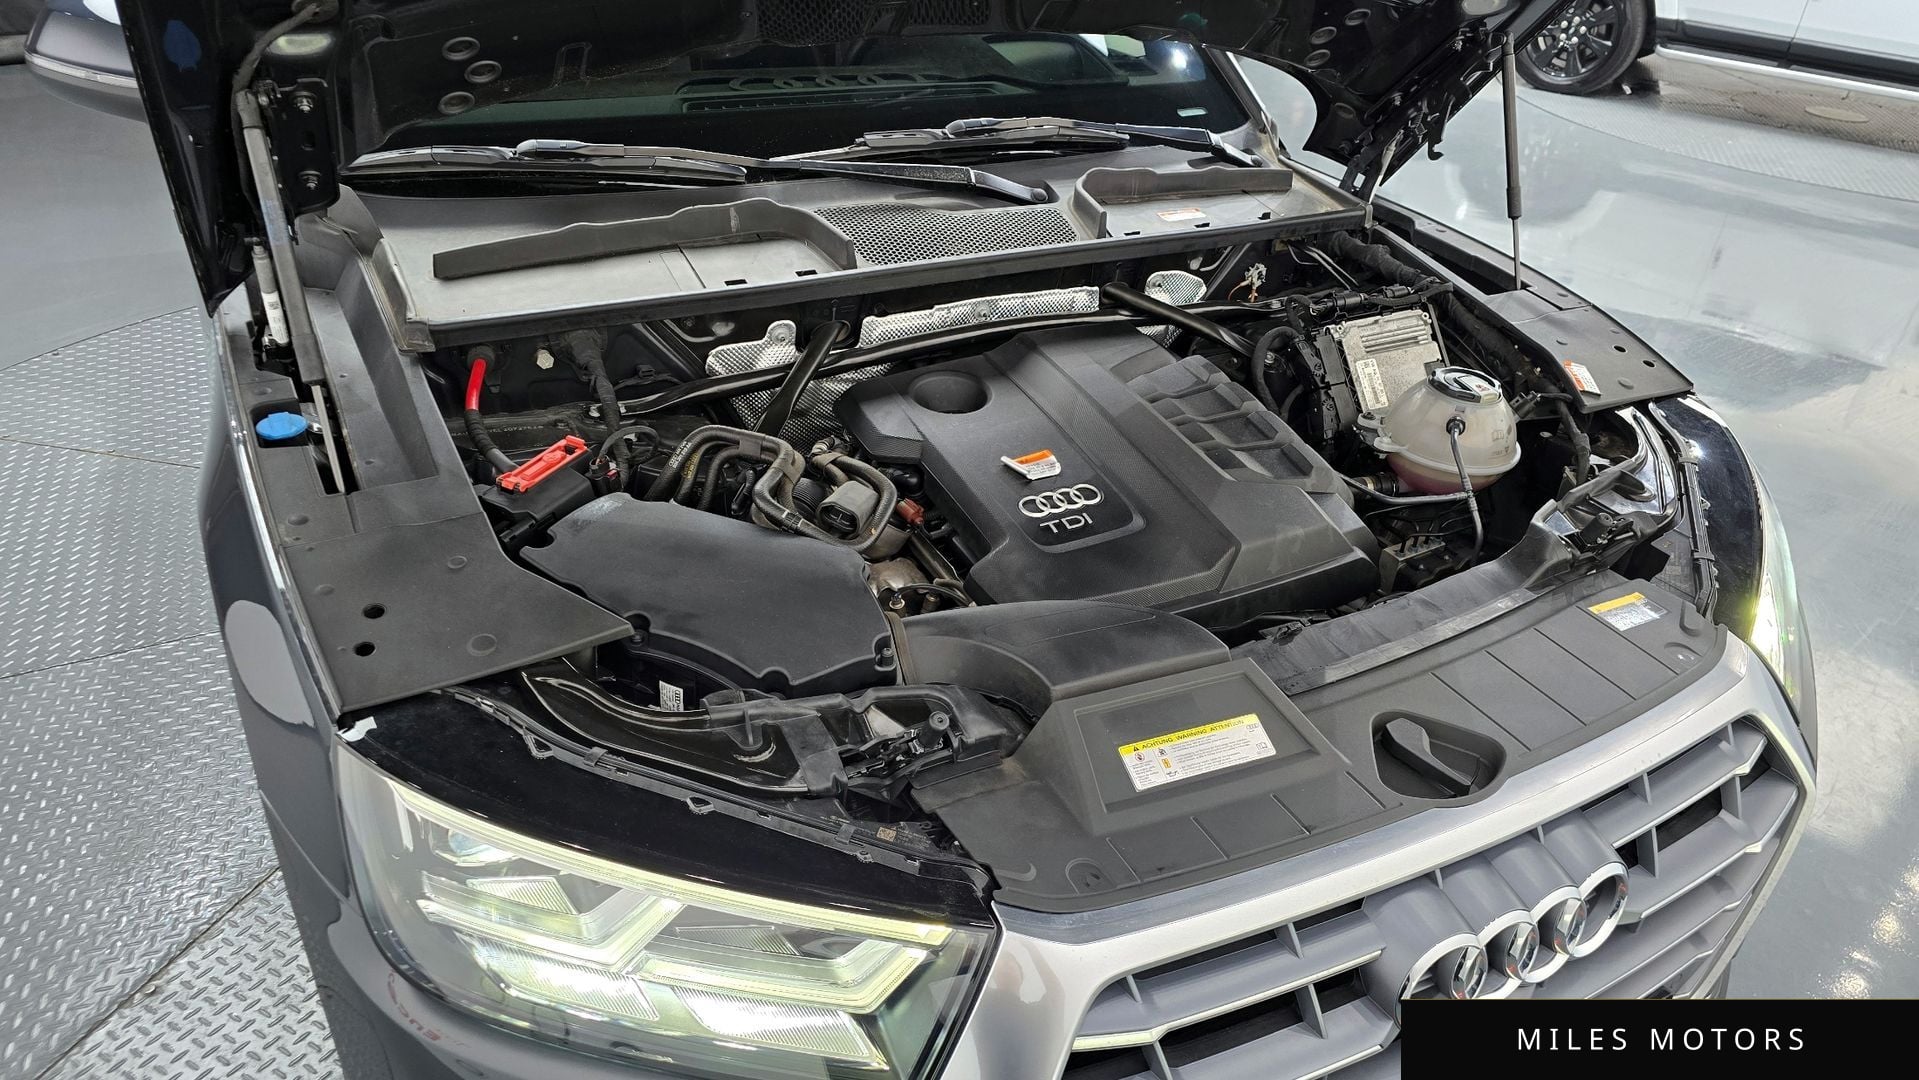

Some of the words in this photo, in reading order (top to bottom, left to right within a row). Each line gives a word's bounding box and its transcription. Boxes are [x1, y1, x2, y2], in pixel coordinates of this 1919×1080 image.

[1039, 512, 1093, 534] TDI
[1142, 738, 1173, 749] ACHTUNG
[1175, 729, 1208, 740] WARNING
[1210, 720, 1244, 732] ATTENTION
